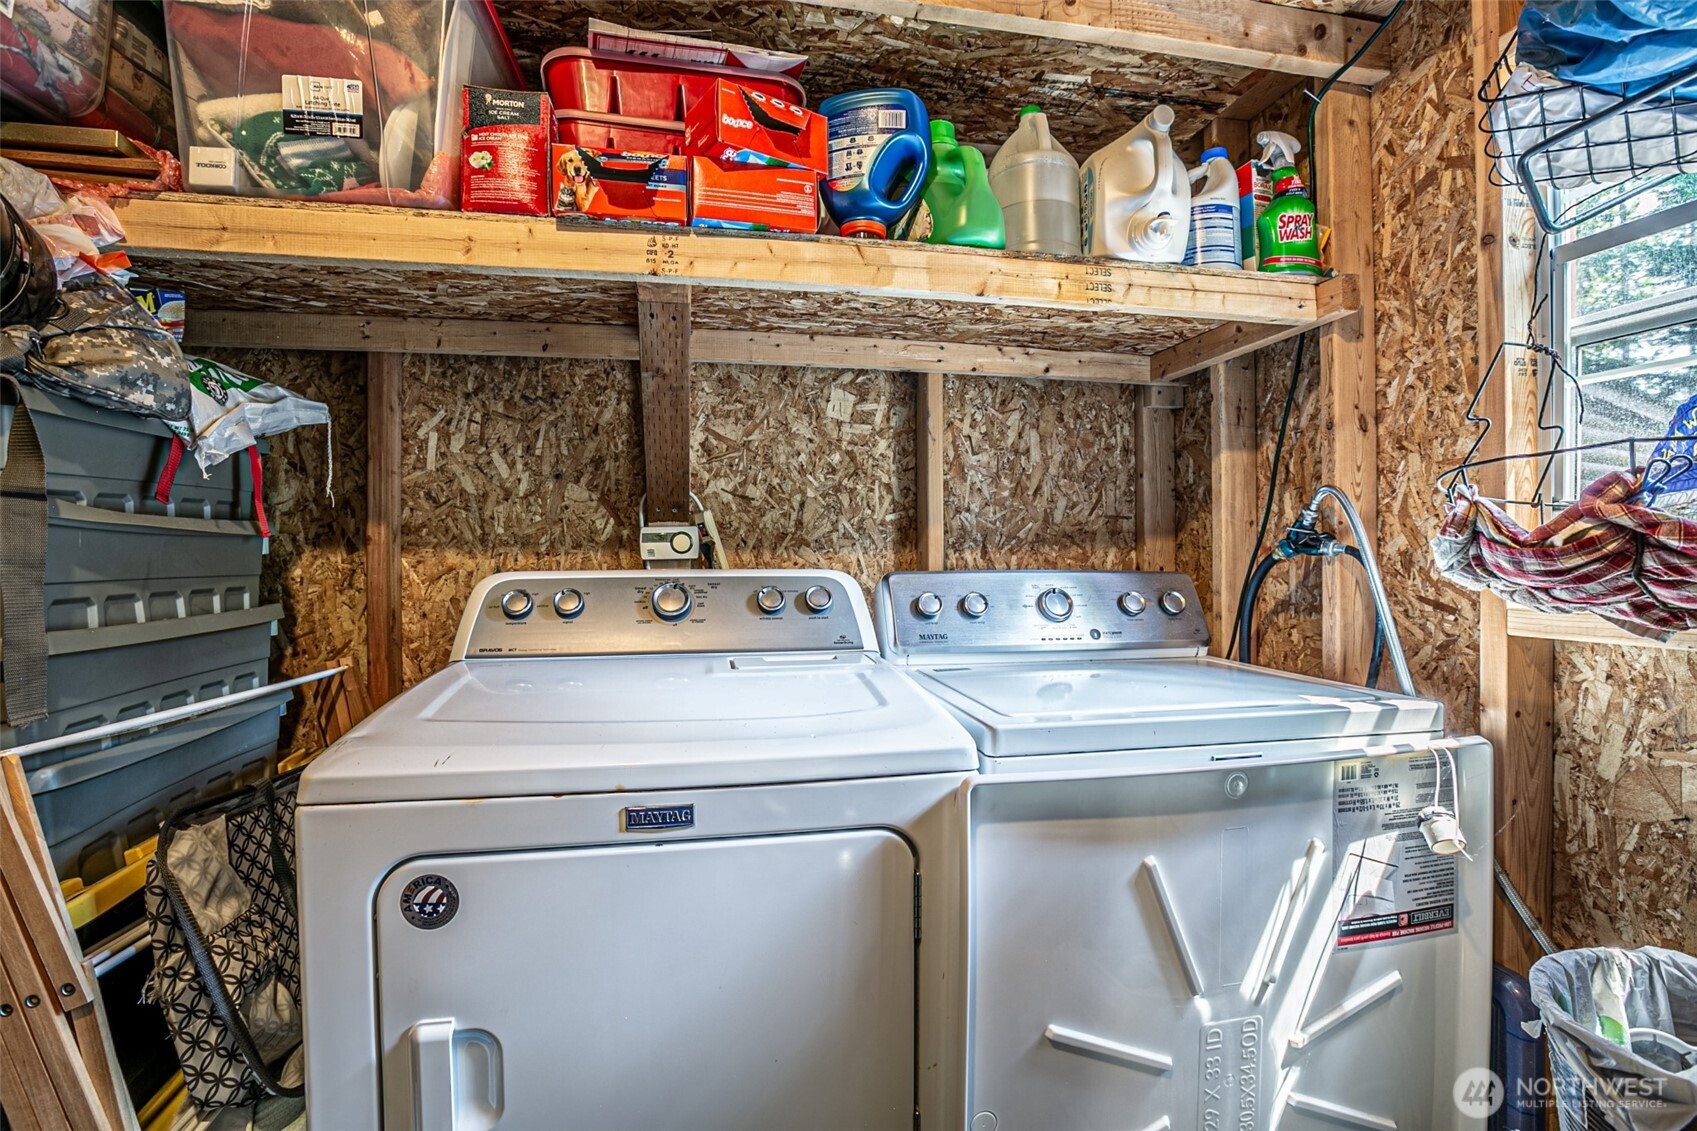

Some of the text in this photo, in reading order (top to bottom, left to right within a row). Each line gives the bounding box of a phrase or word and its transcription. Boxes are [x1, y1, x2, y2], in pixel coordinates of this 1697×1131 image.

[492, 99, 525, 108] MORTON
[1278, 213, 1314, 229] SPRAY
[1279, 228, 1313, 242] WASH
[1085, 267, 1112, 277] SELECT
[1085, 282, 1112, 292] SELECT
[630, 810, 691, 824] MAYTAG
[1413, 909, 1450, 922] EVERBILT
[1204, 1028, 1222, 1131] 29 X 33 ID
